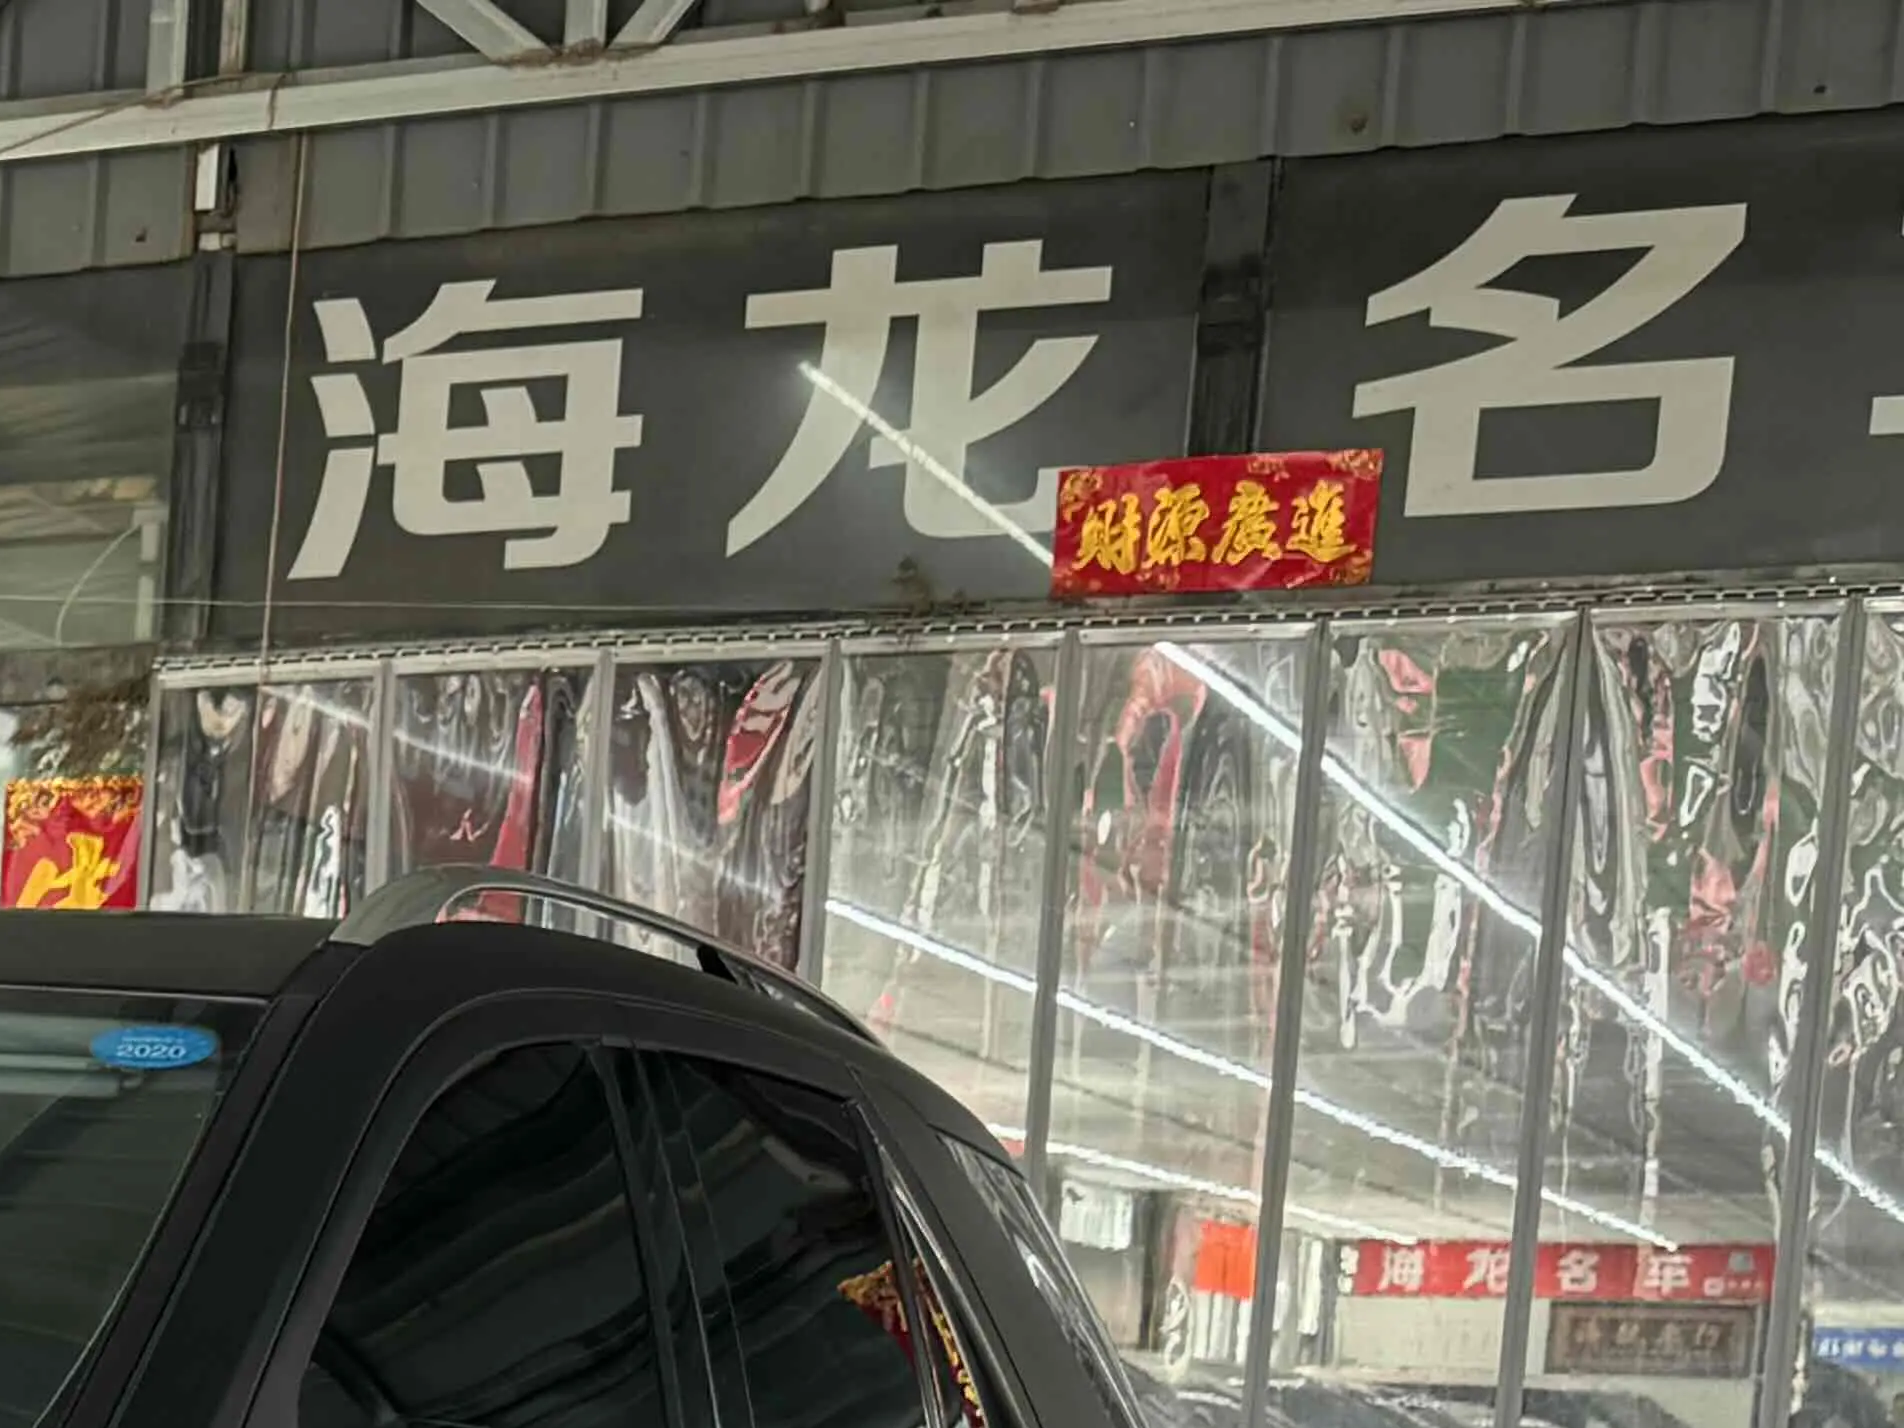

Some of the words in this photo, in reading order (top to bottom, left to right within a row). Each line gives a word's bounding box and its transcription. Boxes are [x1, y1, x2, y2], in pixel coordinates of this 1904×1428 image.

[287, 193, 1904, 580] 海龙名
[116, 1043, 187, 1059] 2020
[1376, 1245, 1694, 1297] 海龙名车
